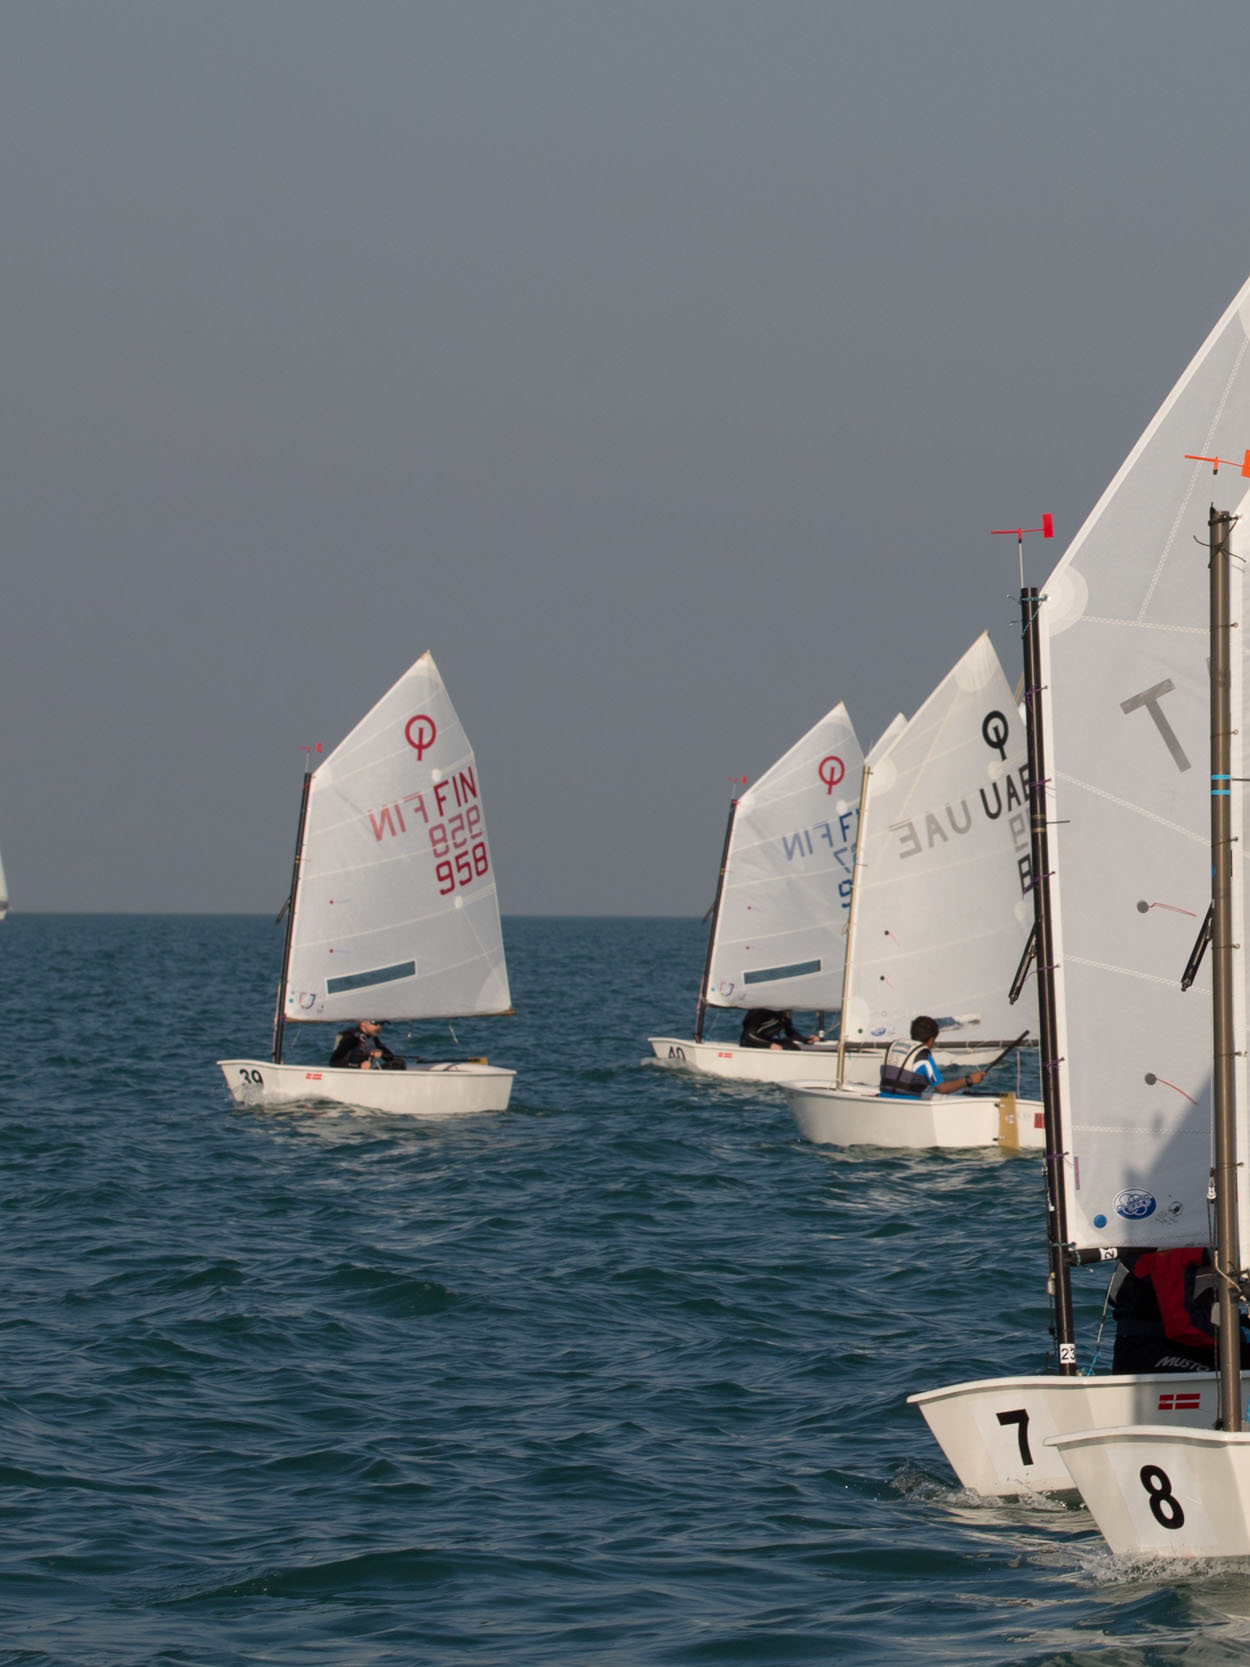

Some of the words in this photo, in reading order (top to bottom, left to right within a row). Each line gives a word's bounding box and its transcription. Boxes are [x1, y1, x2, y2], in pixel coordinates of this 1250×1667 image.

[433, 766, 477, 817] FIN
[435, 841, 488, 896] 958
[1155, 1355, 1210, 1373] MUSTO
[996, 1409, 1034, 1466] 7
[1140, 1464, 1185, 1530] 8
